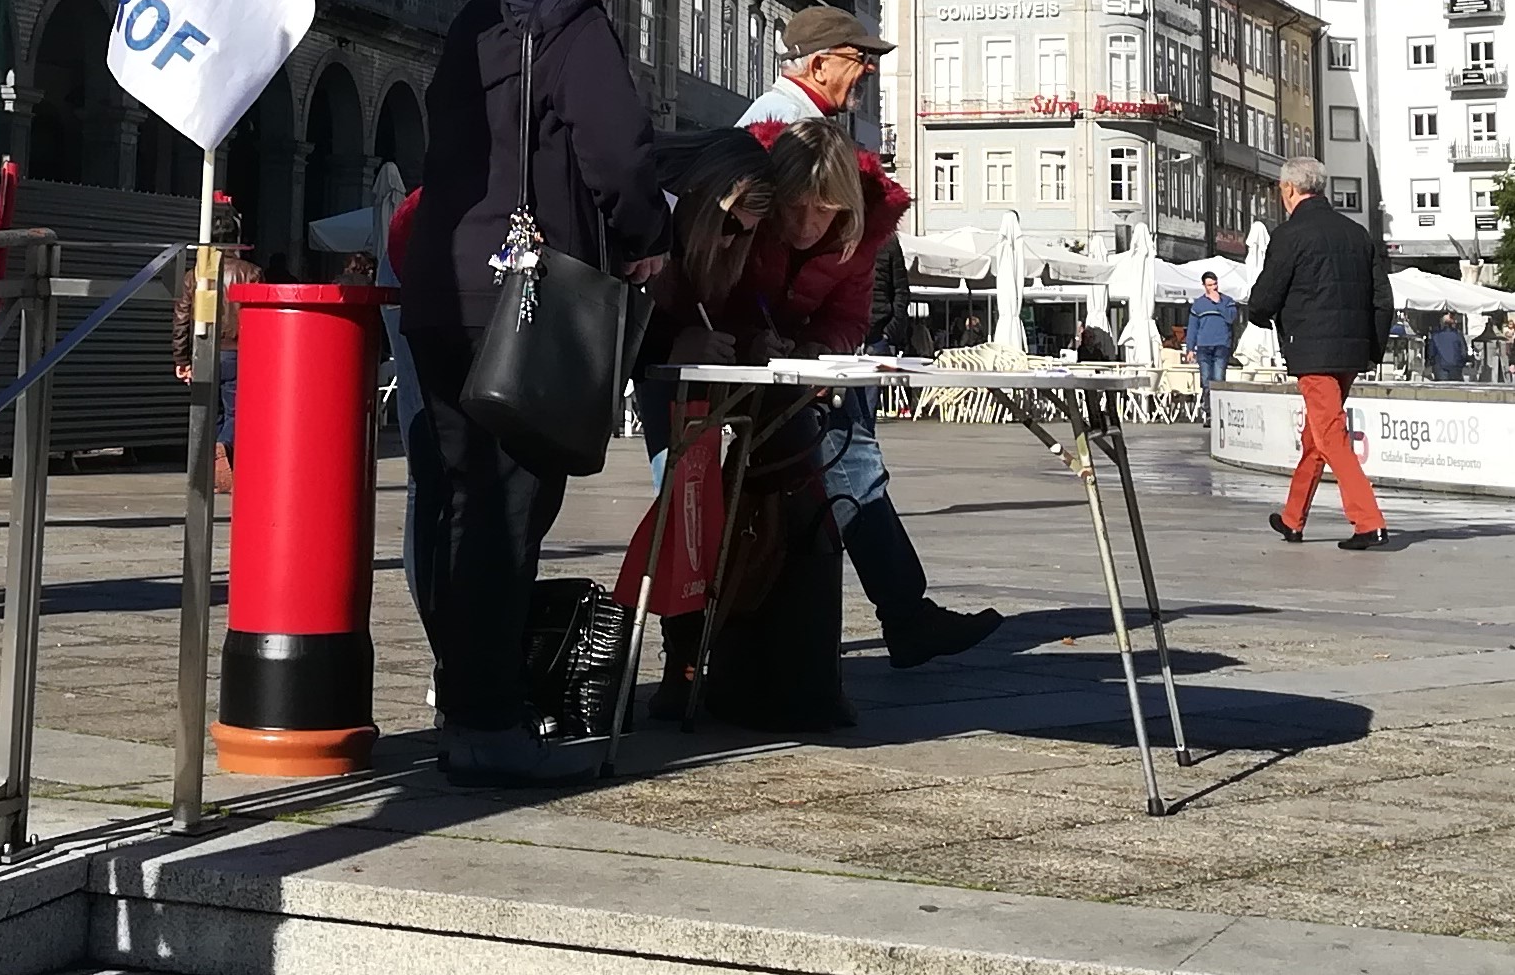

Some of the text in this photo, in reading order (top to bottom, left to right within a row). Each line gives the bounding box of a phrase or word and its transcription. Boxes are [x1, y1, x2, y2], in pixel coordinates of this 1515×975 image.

[936, 0, 1061, 22] COMBUSTÍVEIS
[1379, 411, 1480, 450] Braga 2018
